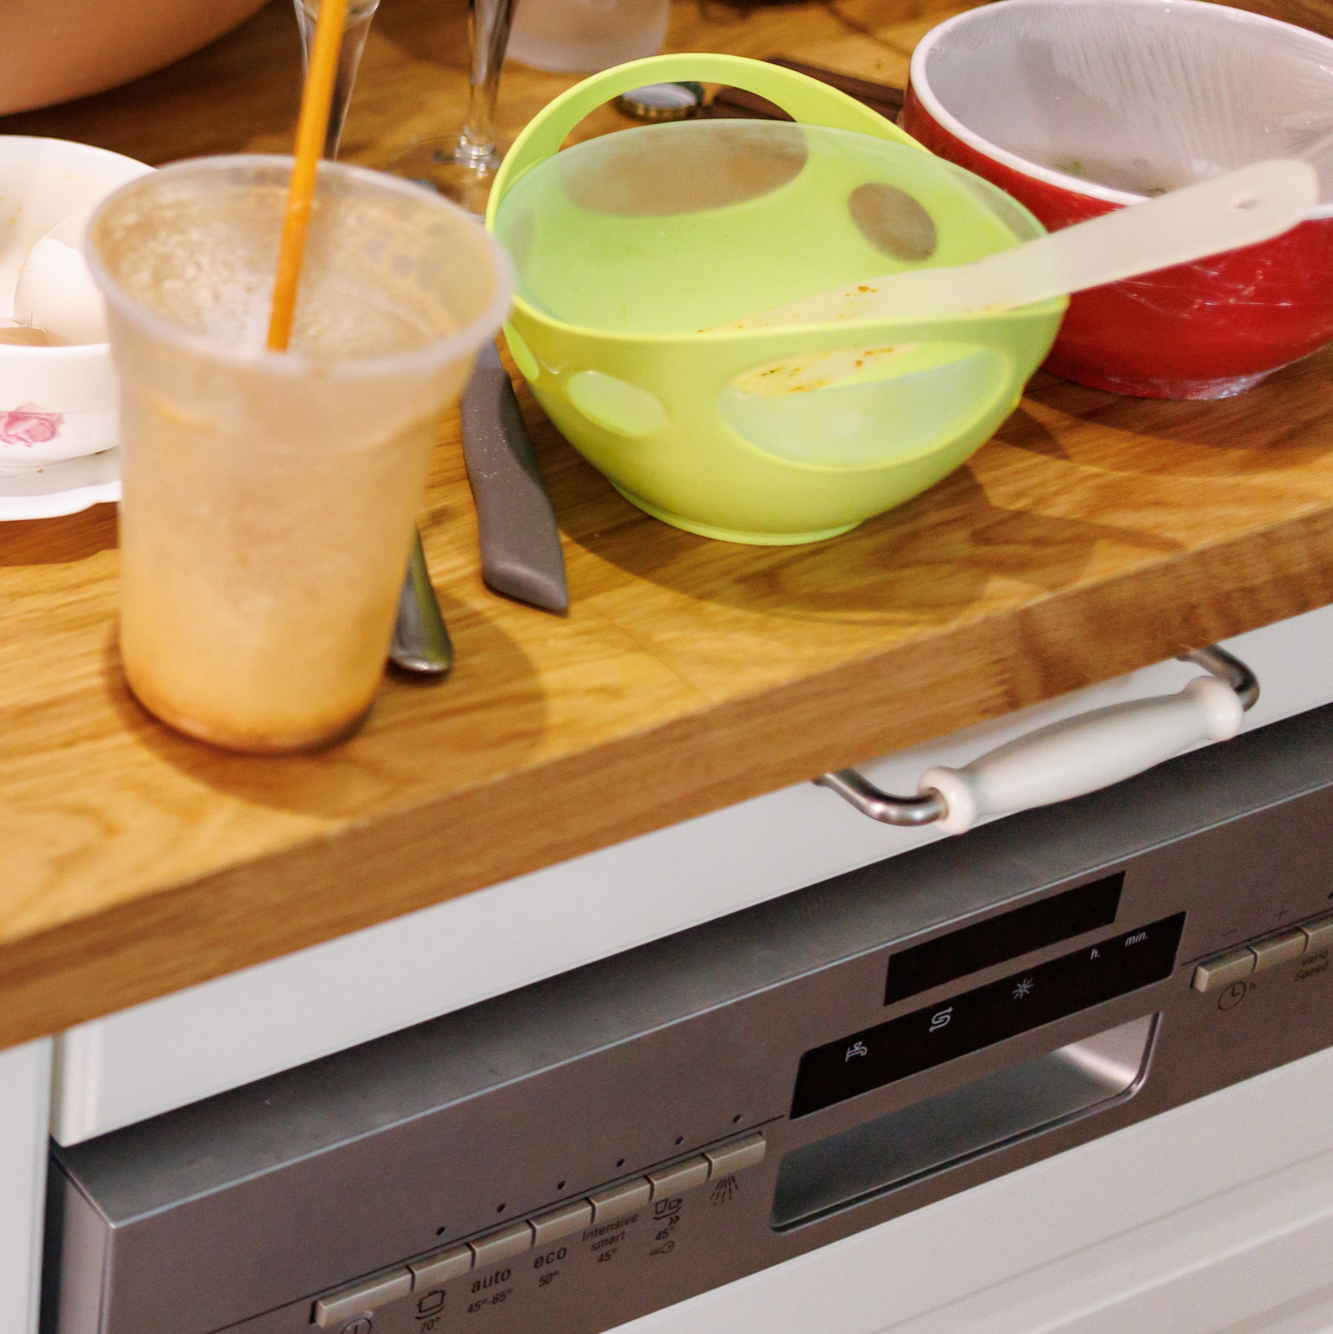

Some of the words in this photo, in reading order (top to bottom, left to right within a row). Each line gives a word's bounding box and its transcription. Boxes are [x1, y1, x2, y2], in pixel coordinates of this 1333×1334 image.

[1124, 931, 1149, 948] min.
[590, 1230, 627, 1253] smart
[533, 1246, 567, 1269] eco
[470, 1267, 511, 1294] auto
